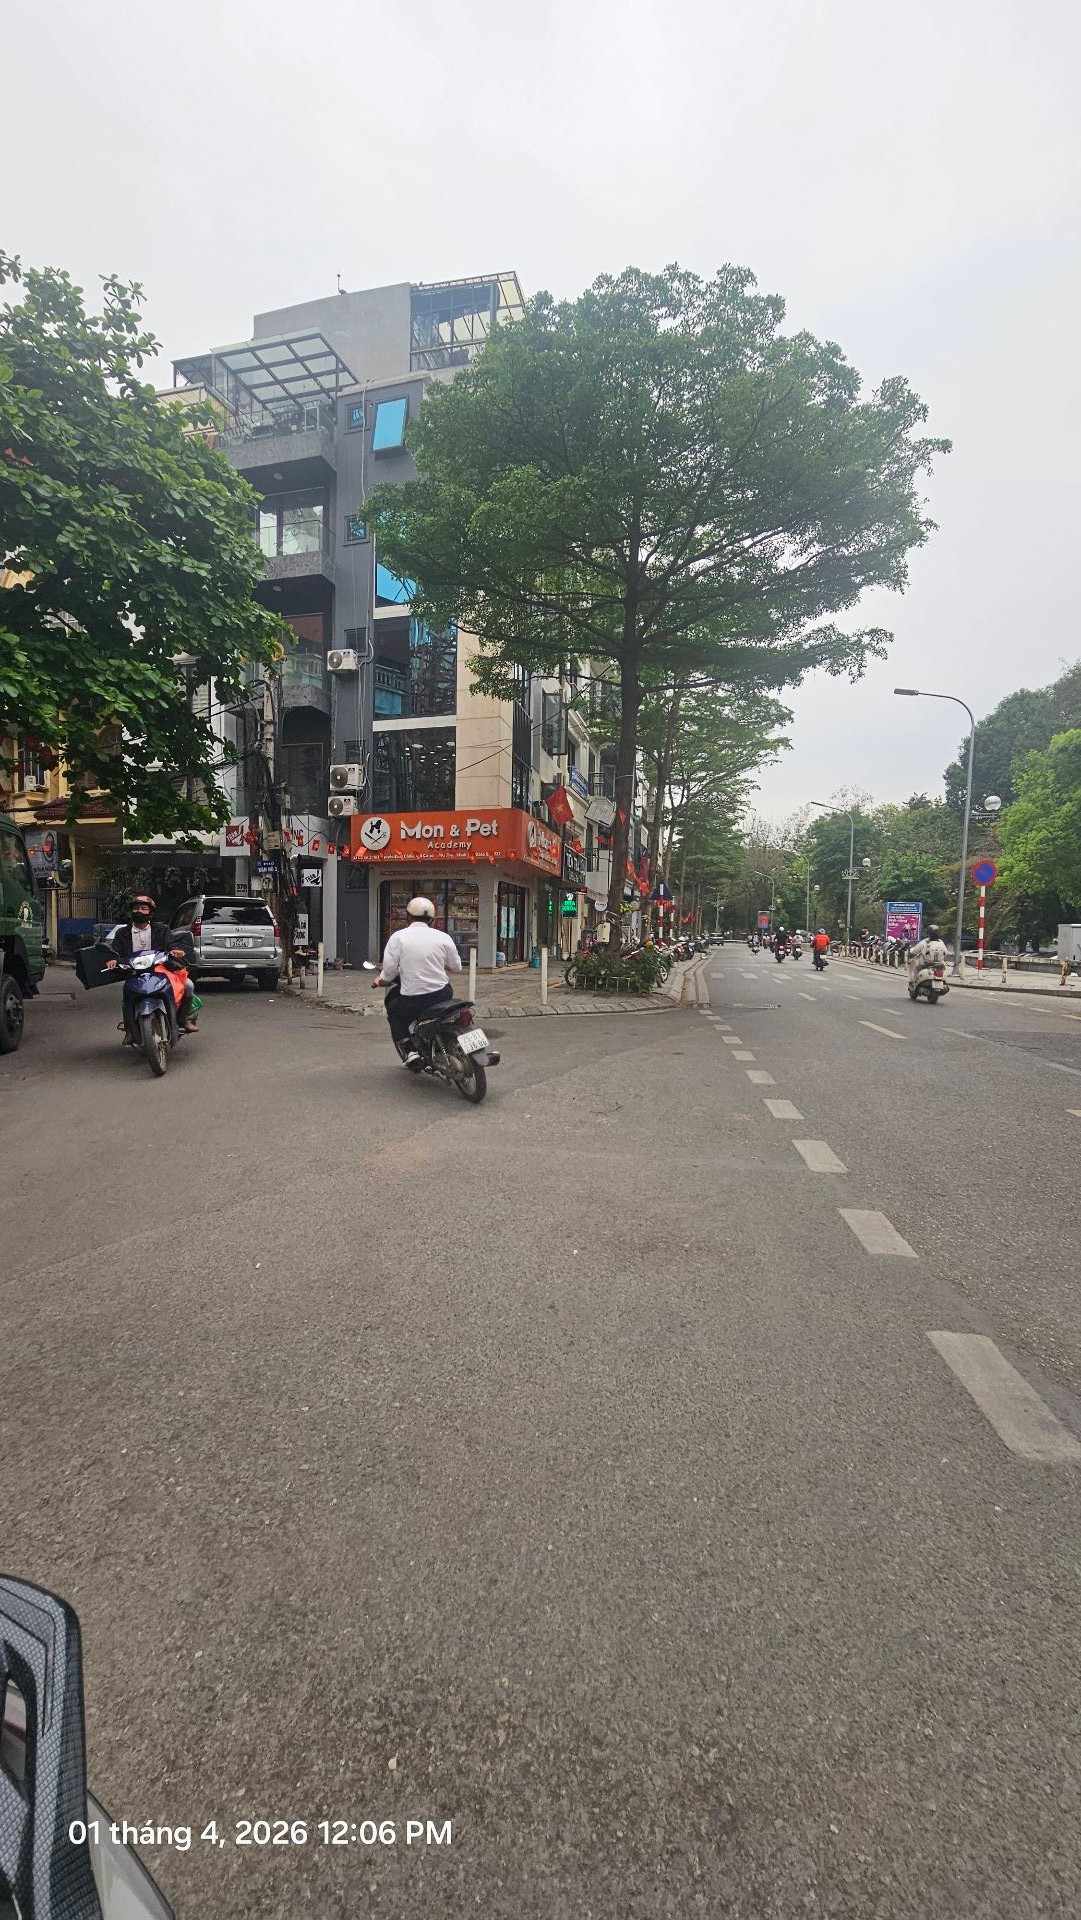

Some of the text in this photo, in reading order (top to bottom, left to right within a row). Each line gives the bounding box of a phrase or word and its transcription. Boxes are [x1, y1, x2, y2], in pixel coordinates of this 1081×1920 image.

[400, 818, 499, 839] Mon & Pet
[427, 840, 472, 850] Academy
